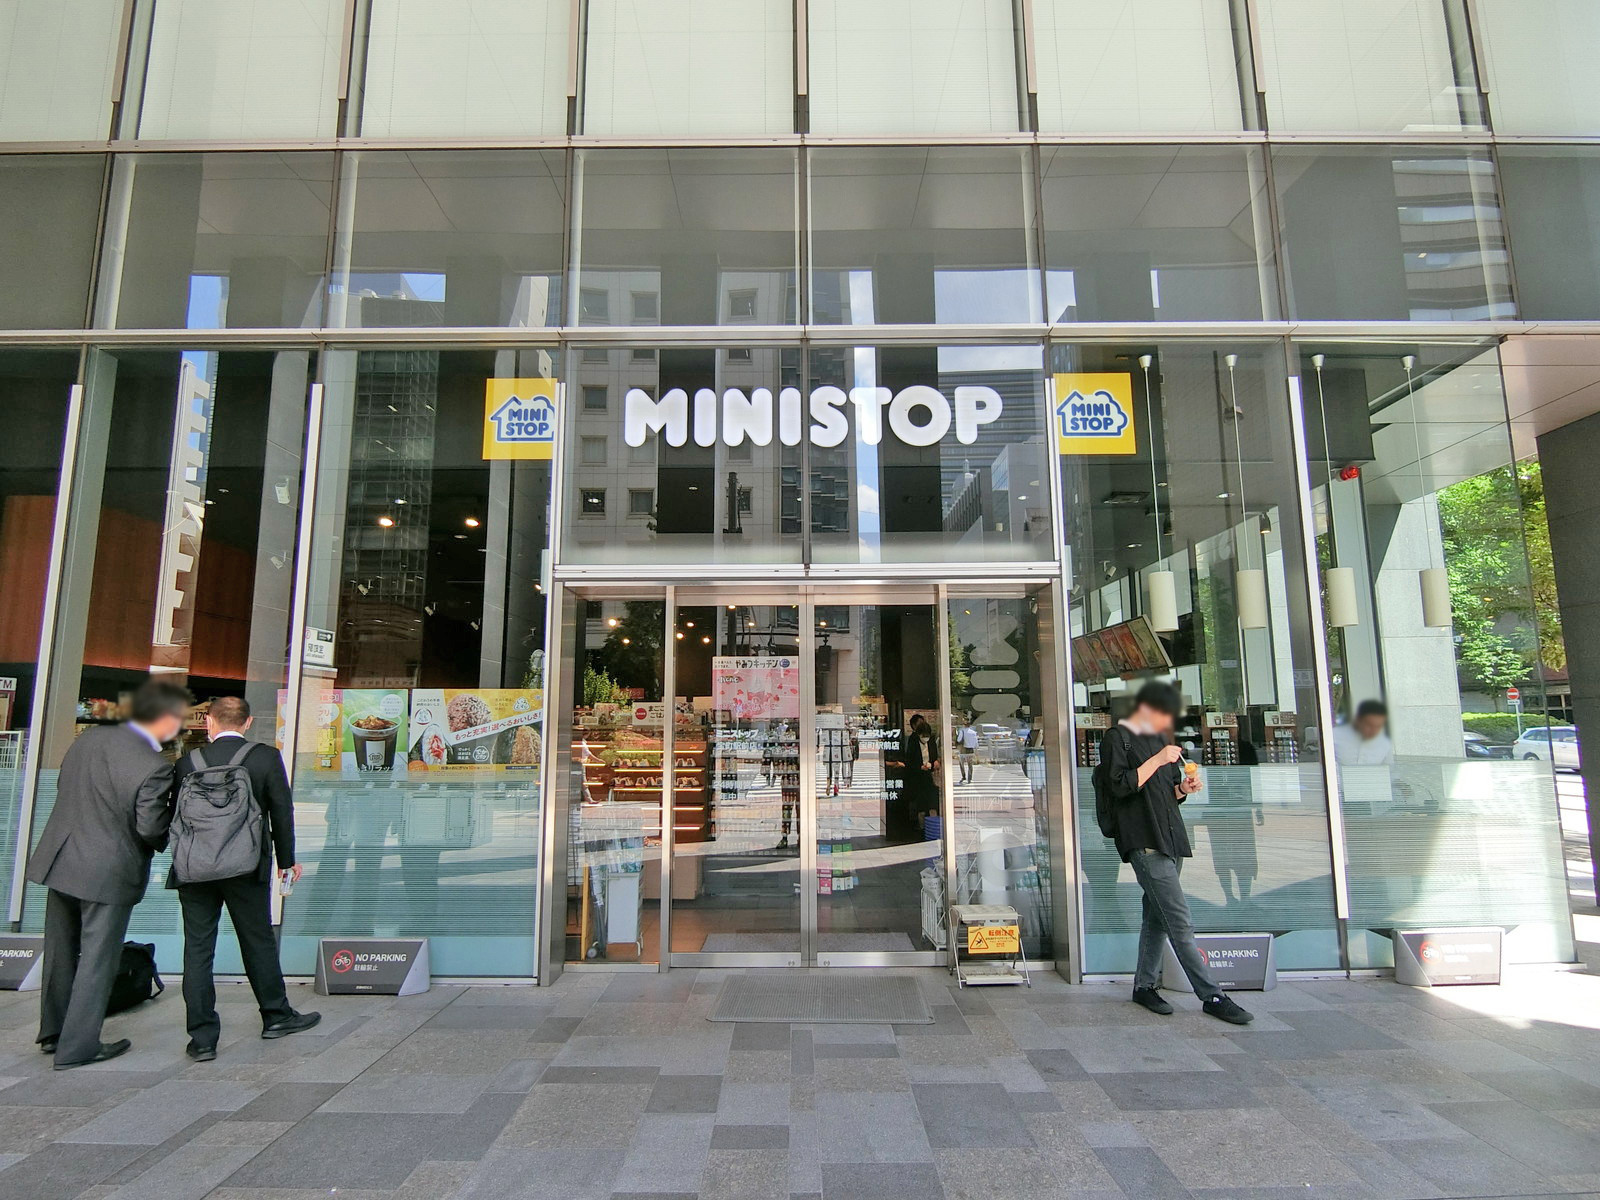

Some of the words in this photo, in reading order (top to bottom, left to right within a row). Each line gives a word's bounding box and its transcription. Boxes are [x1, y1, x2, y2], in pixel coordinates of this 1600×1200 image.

[508, 408, 547, 421] MINI
[1071, 403, 1111, 416] MINI
[624, 385, 1003, 448] MINISTOP
[505, 422, 549, 436] STOP
[1070, 417, 1114, 431] STOP
[715, 729, 759, 738] ミニストップ
[857, 728, 901, 738] ミニストップ
[858, 741, 900, 750] 宝町駅前店
[712, 780, 759, 790] 24時間営
[369, 954, 407, 962] PARKING
[1207, 950, 1220, 958] NO
[1222, 950, 1259, 958] PARKING
